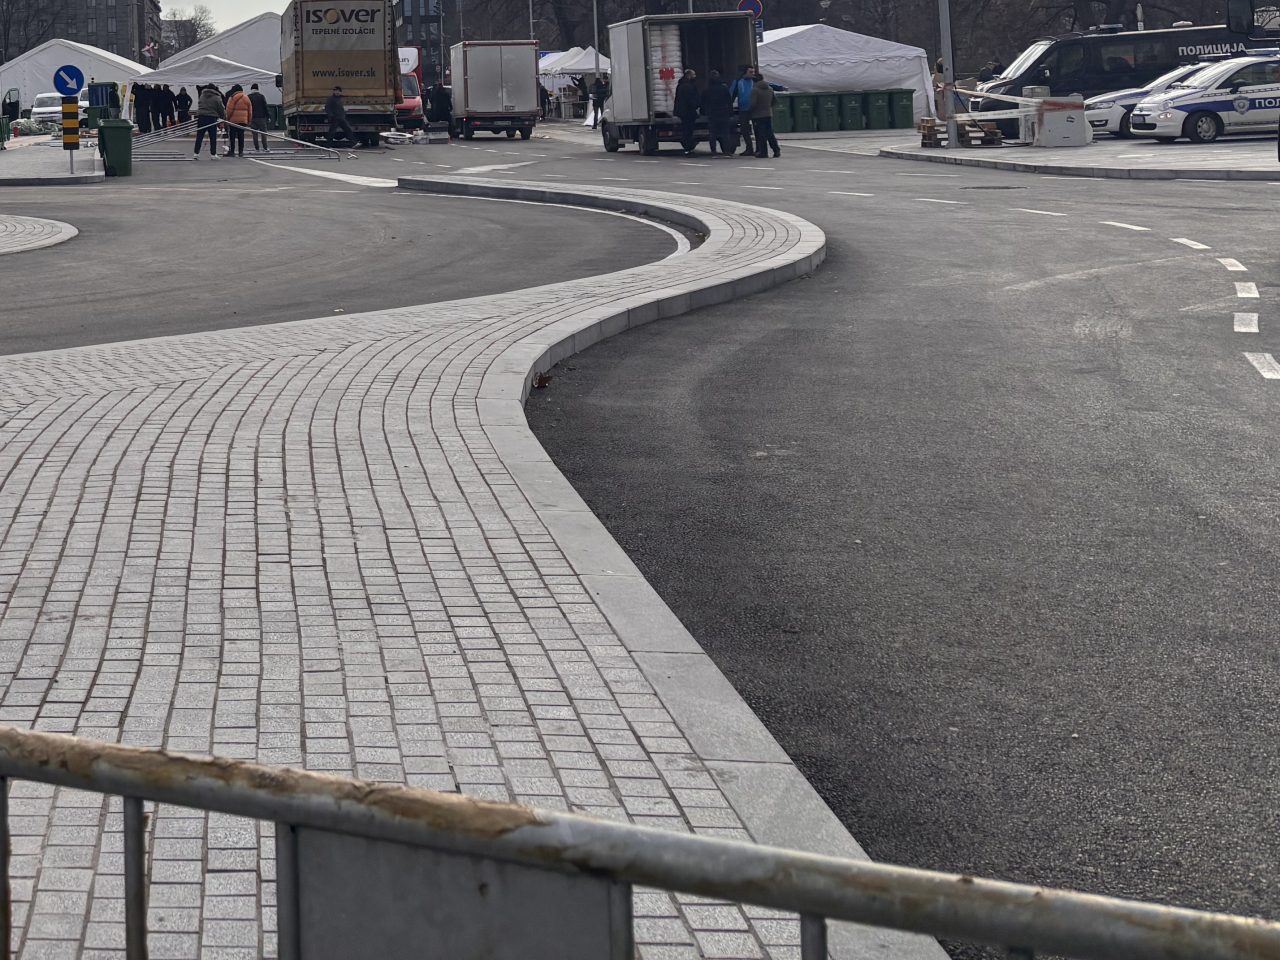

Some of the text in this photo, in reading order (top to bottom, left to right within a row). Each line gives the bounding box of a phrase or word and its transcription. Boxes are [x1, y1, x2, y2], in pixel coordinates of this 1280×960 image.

[342, 26, 376, 35] IZOLÁCIE
[1178, 43, 1246, 56] ПОЛИЦИЈА
[312, 67, 376, 77] www.isover.sk
